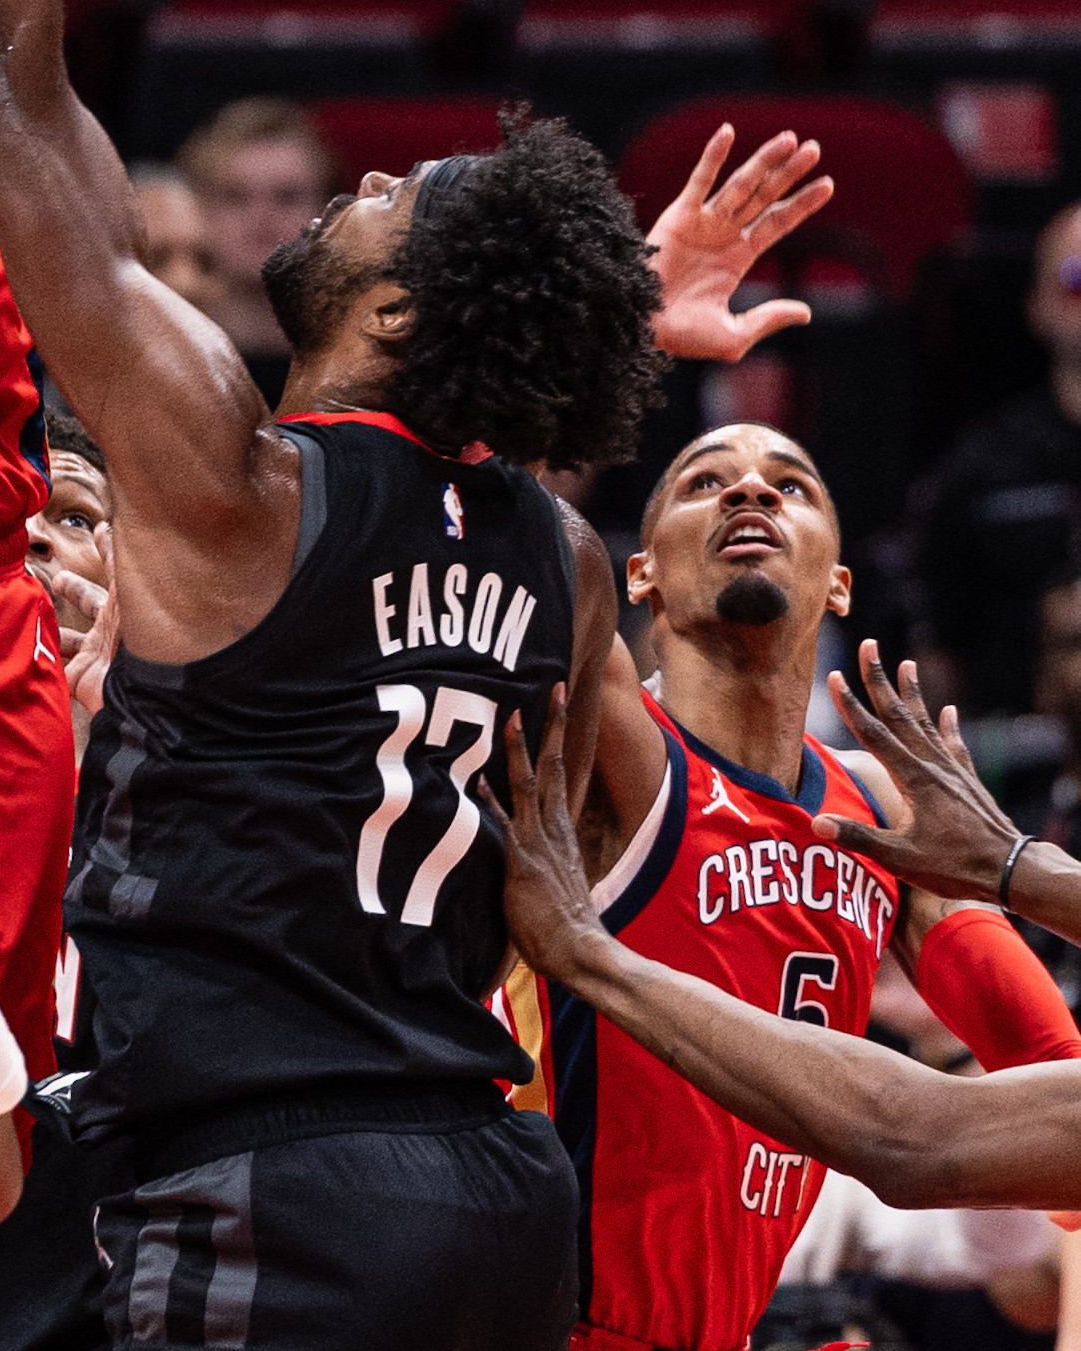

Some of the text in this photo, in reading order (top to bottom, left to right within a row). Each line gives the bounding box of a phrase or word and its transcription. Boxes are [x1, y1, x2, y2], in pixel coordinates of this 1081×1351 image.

[372, 562, 537, 673] EASON
[356, 683, 498, 927] 17
[697, 839, 894, 961] CRESCENT
